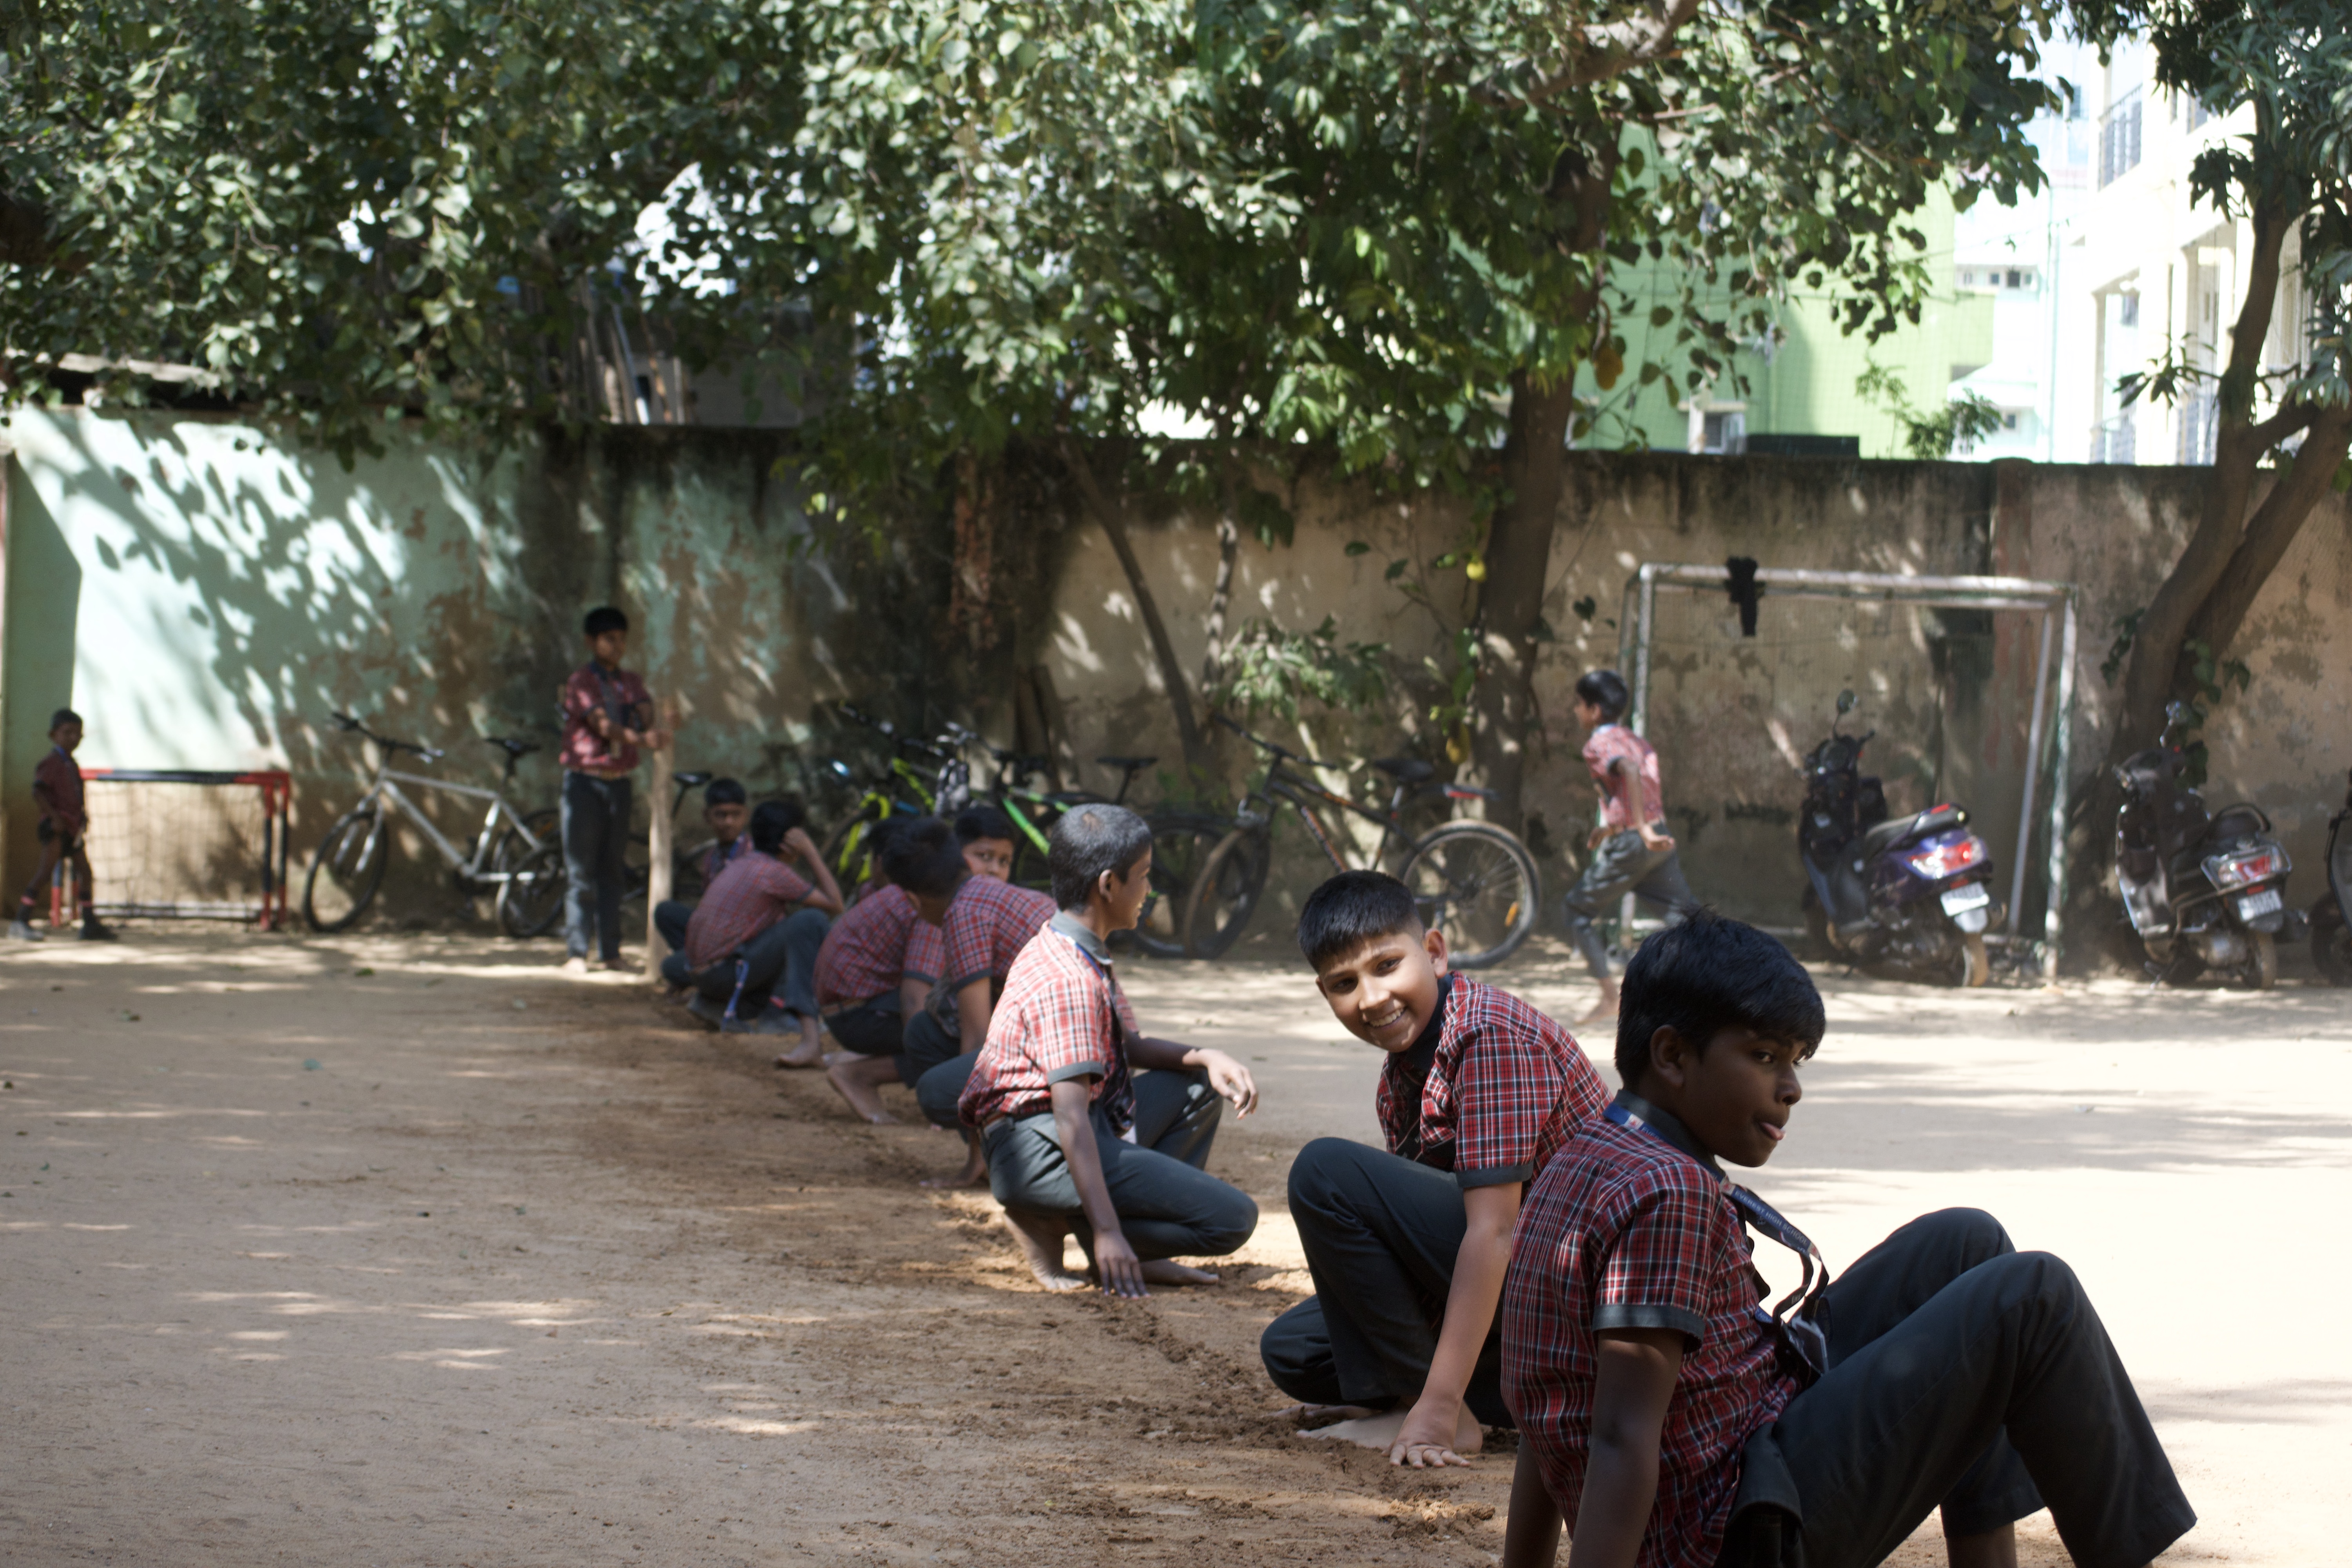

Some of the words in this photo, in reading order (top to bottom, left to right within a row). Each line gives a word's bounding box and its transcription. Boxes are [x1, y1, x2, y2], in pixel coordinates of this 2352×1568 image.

[1735, 1190, 1766, 1214] EVEREST
[1766, 1212, 1782, 1226] HIGH
[1783, 1223, 1807, 1245] SCHOOL
